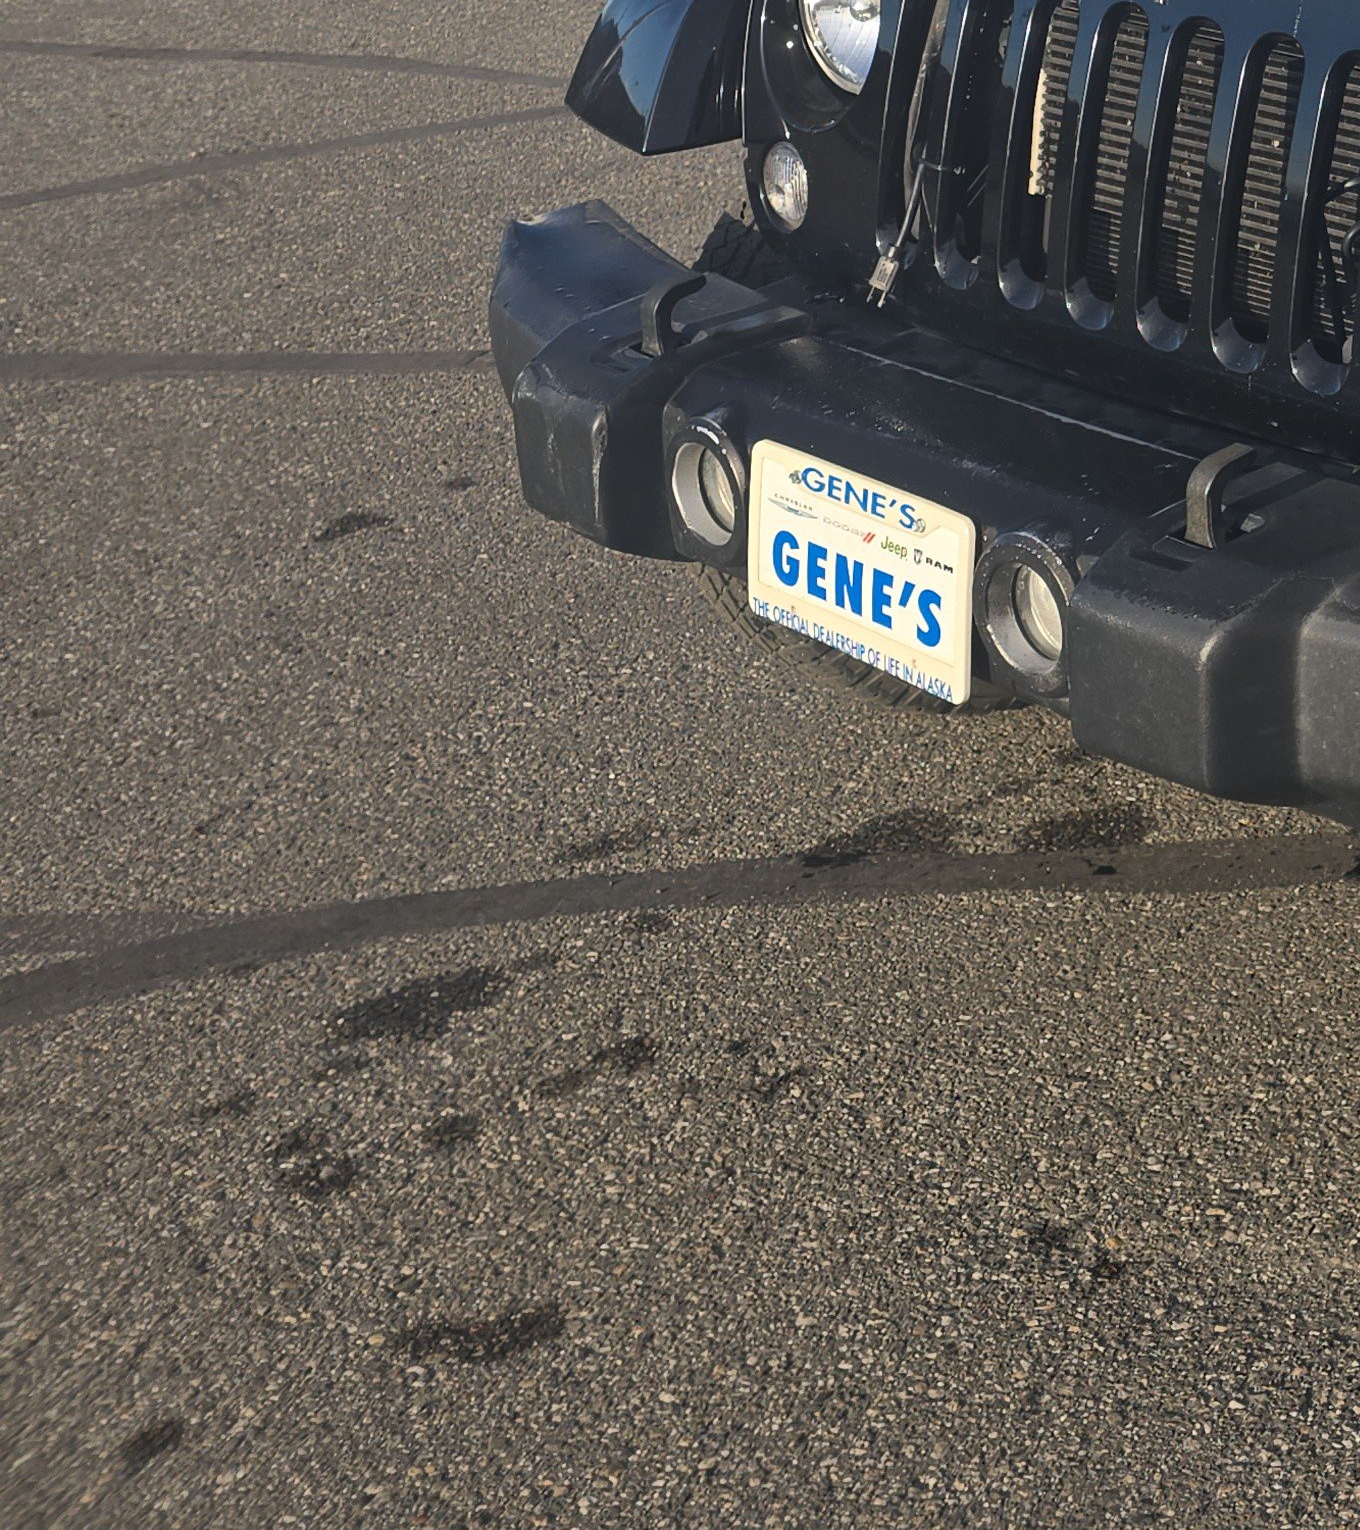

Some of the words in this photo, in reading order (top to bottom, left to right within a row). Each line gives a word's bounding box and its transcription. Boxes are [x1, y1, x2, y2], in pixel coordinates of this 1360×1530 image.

[774, 493, 814, 512] CHRYSLER
[801, 466, 917, 531] GENE'S
[880, 535, 907, 560] Jeep
[925, 556, 954, 574] RAM
[772, 529, 942, 648] GENE'S
[752, 596, 770, 618] THE
[773, 606, 810, 637] OFFICIAL
[812, 622, 866, 661] DEALERSHIP
[867, 647, 881, 668] OF
[883, 654, 901, 677] LIFE
[902, 663, 914, 684] IN
[915, 672, 954, 702] ALASKA
